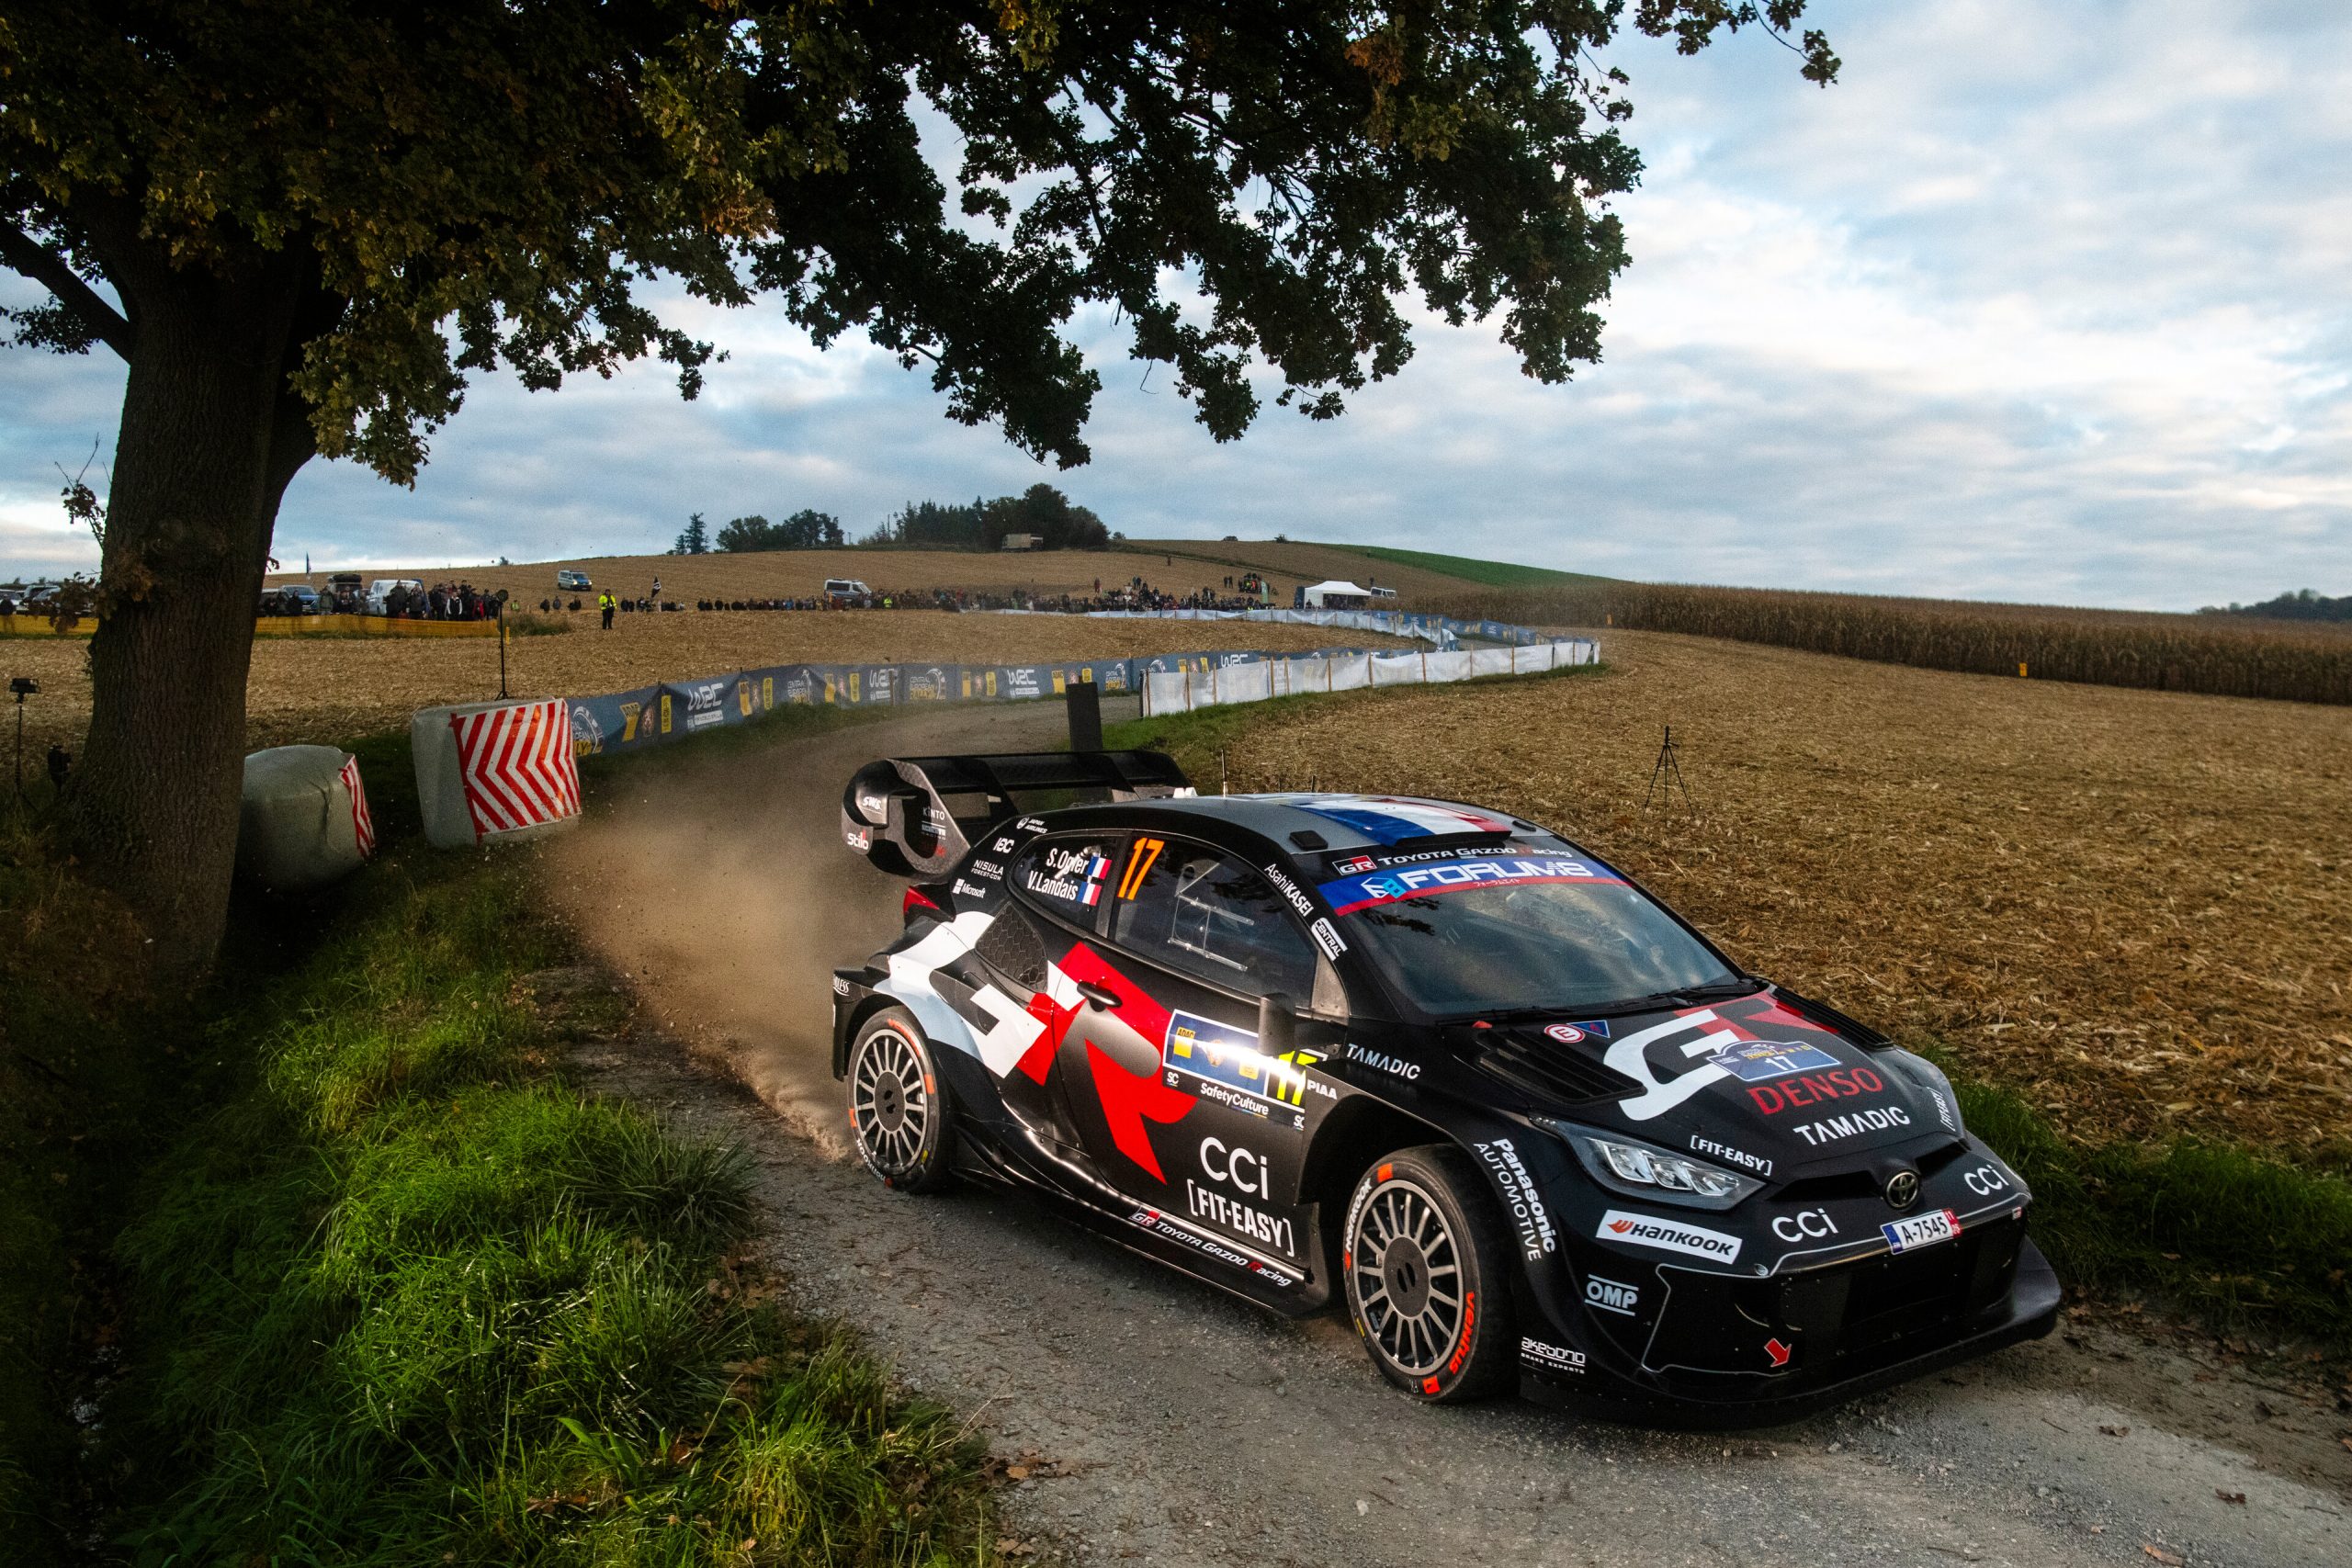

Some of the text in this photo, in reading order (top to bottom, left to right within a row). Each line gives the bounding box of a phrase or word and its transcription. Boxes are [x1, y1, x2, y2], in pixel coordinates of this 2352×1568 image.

[974, 860, 1004, 875] NISULA
[1117, 837, 1165, 901] 17
[1339, 845, 1573, 874] GR TOYOTA GAZOO Racing
[1396, 861, 1594, 889] FORUM8
[961, 883, 986, 898] Microsoft
[1314, 920, 1342, 957] CENTRAL
[1346, 1043, 1421, 1080] TAMADIC
[1764, 1055, 1799, 1071] 17
[1167, 1071, 1179, 1085] SC
[1306, 1078, 1337, 1100] PIAA
[1747, 1067, 1883, 1115] DENSO
[1200, 1082, 1269, 1116] SafetyCulture
[1792, 1106, 1911, 1145] TAMADIC
[1473, 1143, 1542, 1261] AUTOMOTIVE
[1491, 1138, 1556, 1253] Panasonic
[1901, 1216, 1948, 1245] A-7545
[1133, 1213, 1293, 1287] GR TOYOTA GAZOO Racing
[1586, 1280, 1638, 1309] OMP
[1521, 1352, 1585, 1374] BRAKE EXPERTS
